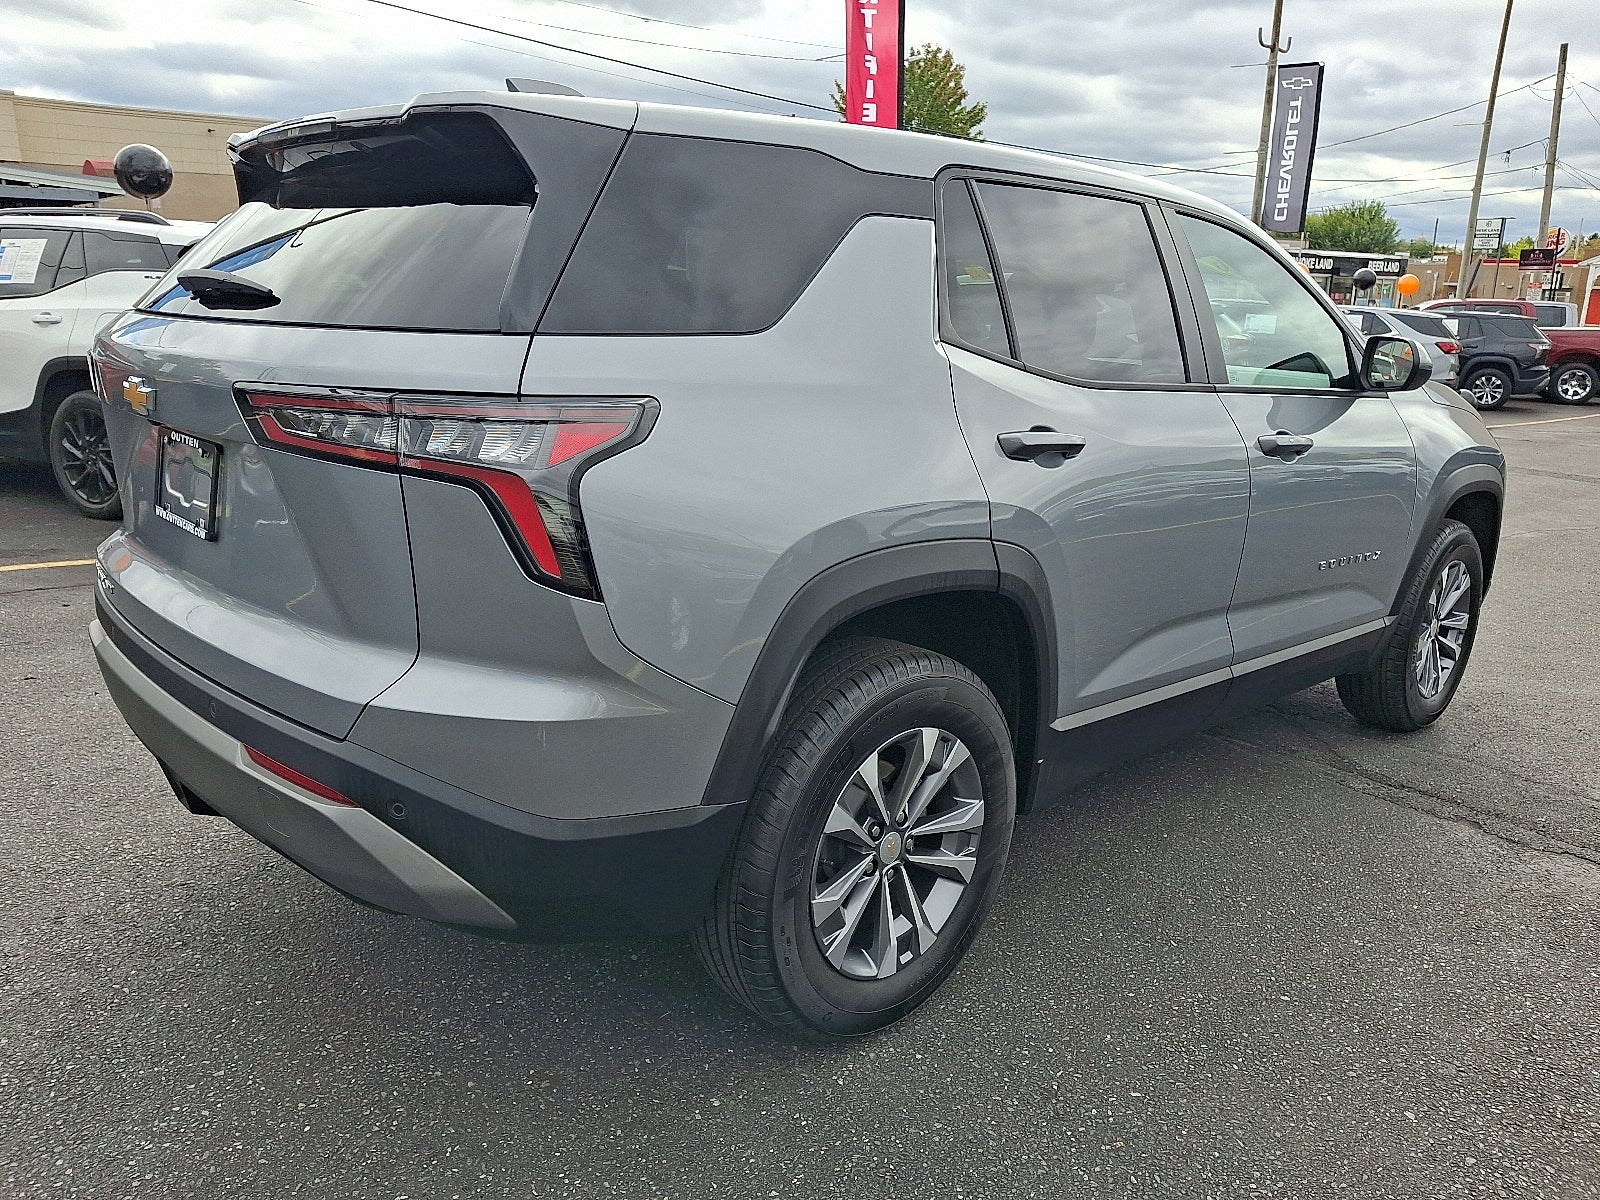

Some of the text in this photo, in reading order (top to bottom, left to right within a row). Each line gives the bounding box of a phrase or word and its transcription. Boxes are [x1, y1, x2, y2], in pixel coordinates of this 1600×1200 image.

[1315, 257, 1334, 270] LAND
[1367, 260, 1400, 273] BEER LAND
[171, 430, 200, 449] OUTTEN
[1318, 550, 1382, 570] EQUINOX
